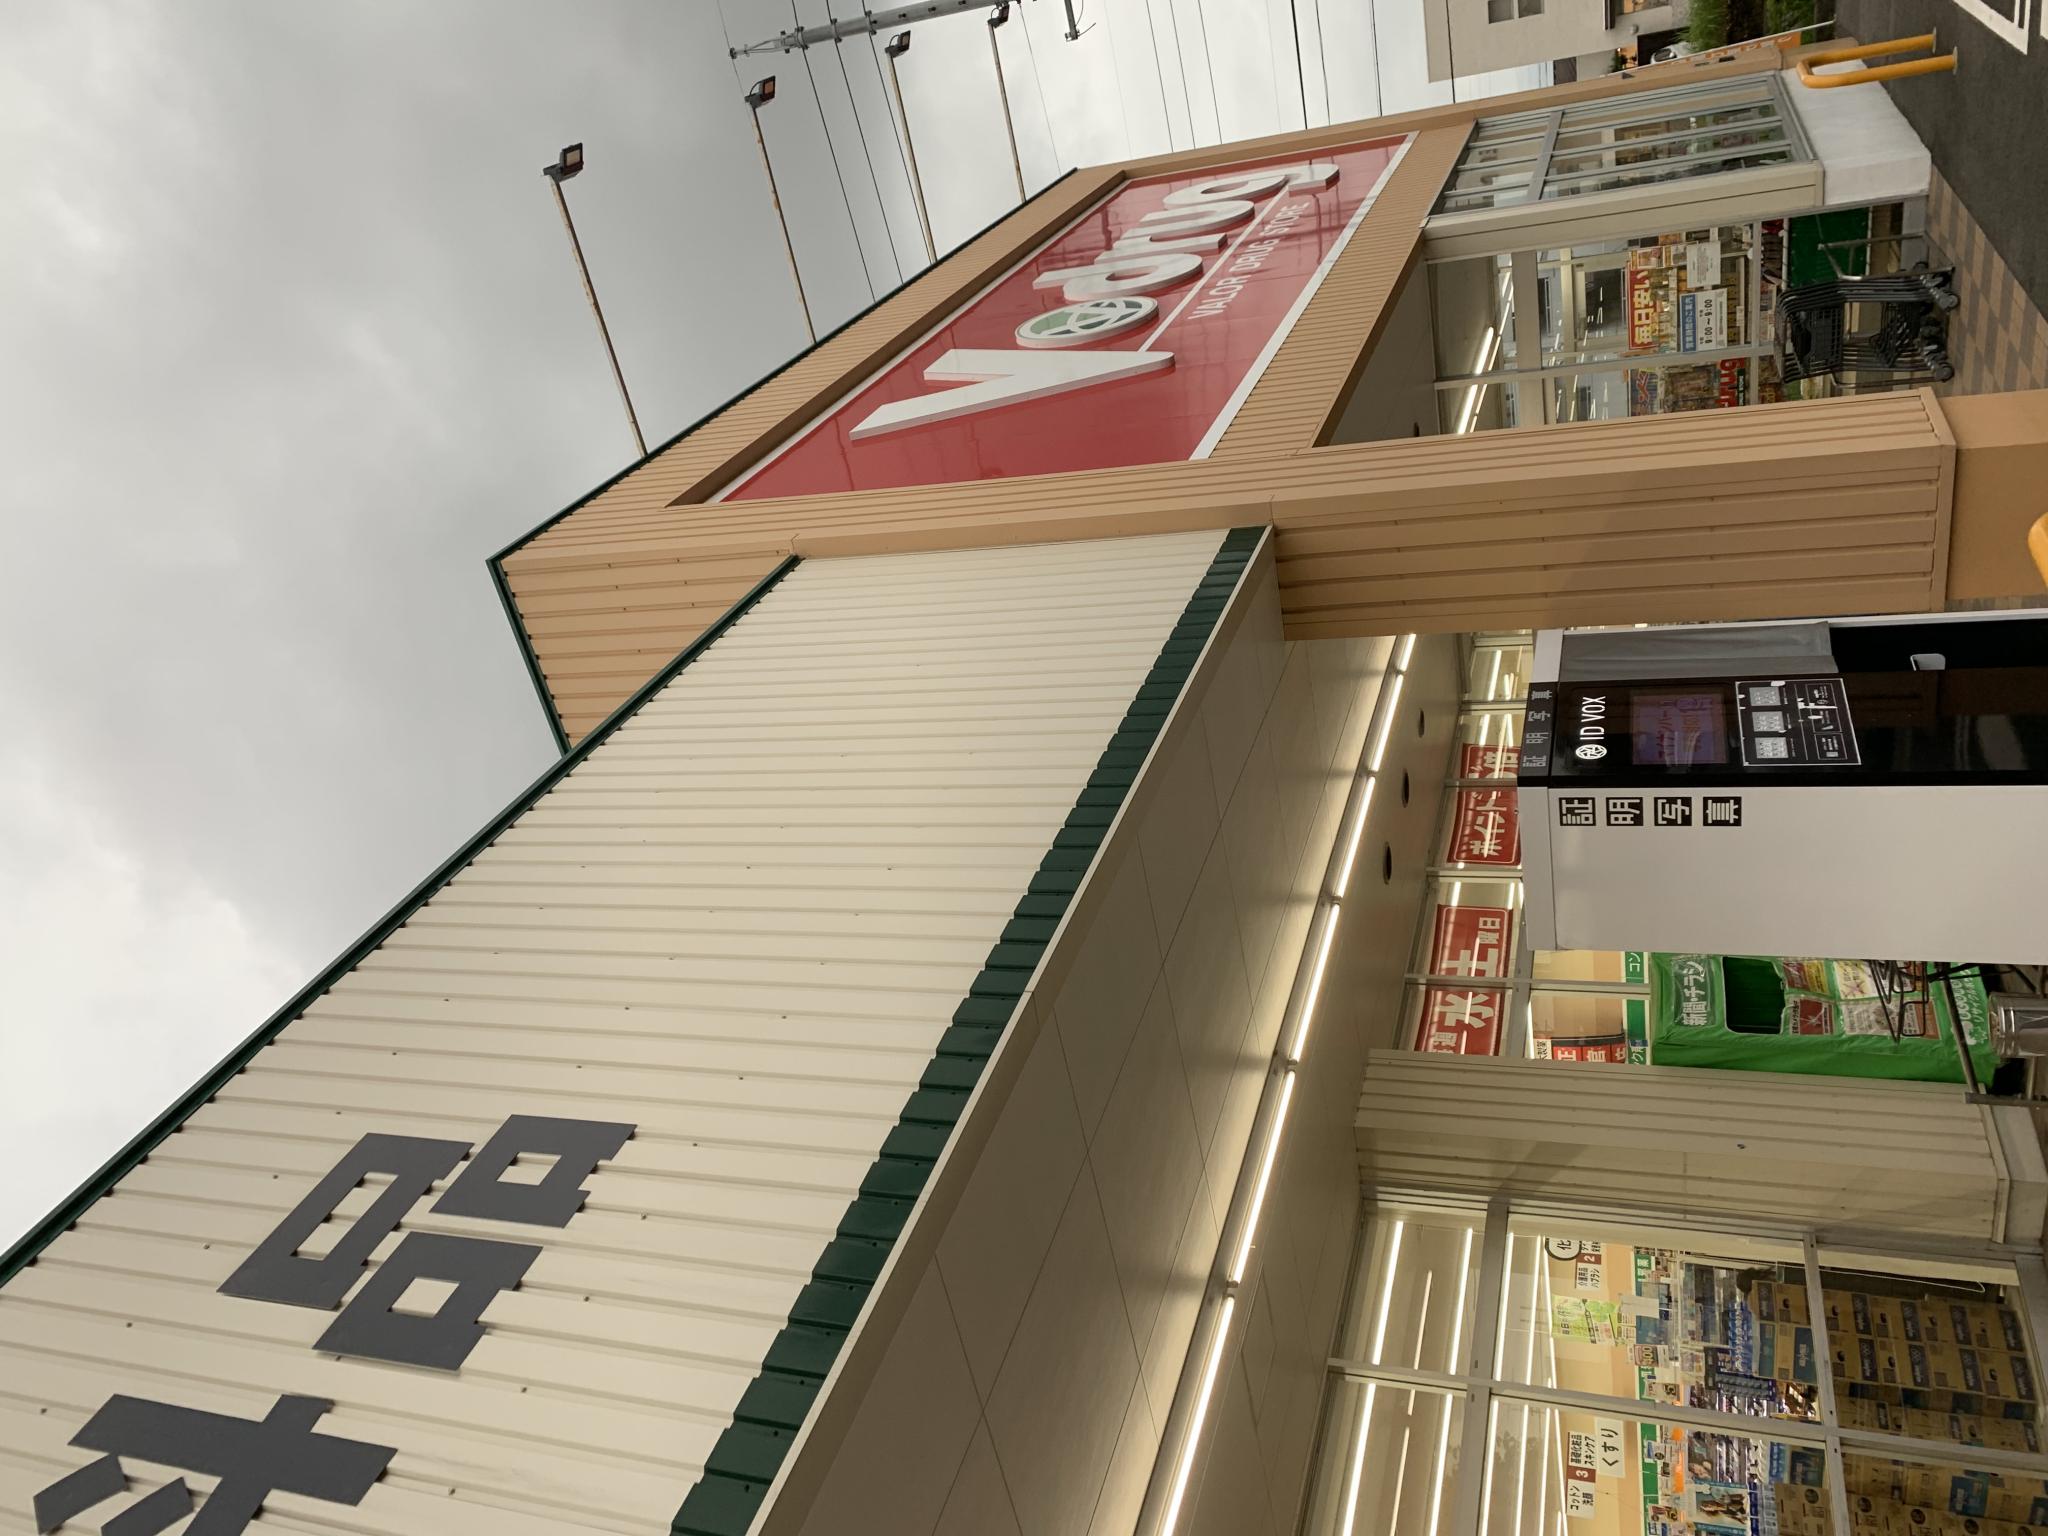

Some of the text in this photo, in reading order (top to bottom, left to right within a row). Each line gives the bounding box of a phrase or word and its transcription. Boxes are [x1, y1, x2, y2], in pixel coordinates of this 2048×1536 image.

[1187, 202, 1310, 320] VALOR DRUG STORE
[1633, 270, 1654, 344] 毎日安い
[1522, 689, 1552, 767] 証明写真
[1580, 696, 1606, 740] ID VOX
[1561, 799, 1738, 825] 証明写真
[1681, 961, 1707, 1025] 新聞・チラシ
[1585, 1436, 1594, 1466] スキンケア
[1600, 1428, 1619, 1467] くすり
[1576, 1470, 1588, 1478] 3
[1570, 1485, 1580, 1511] コットン
